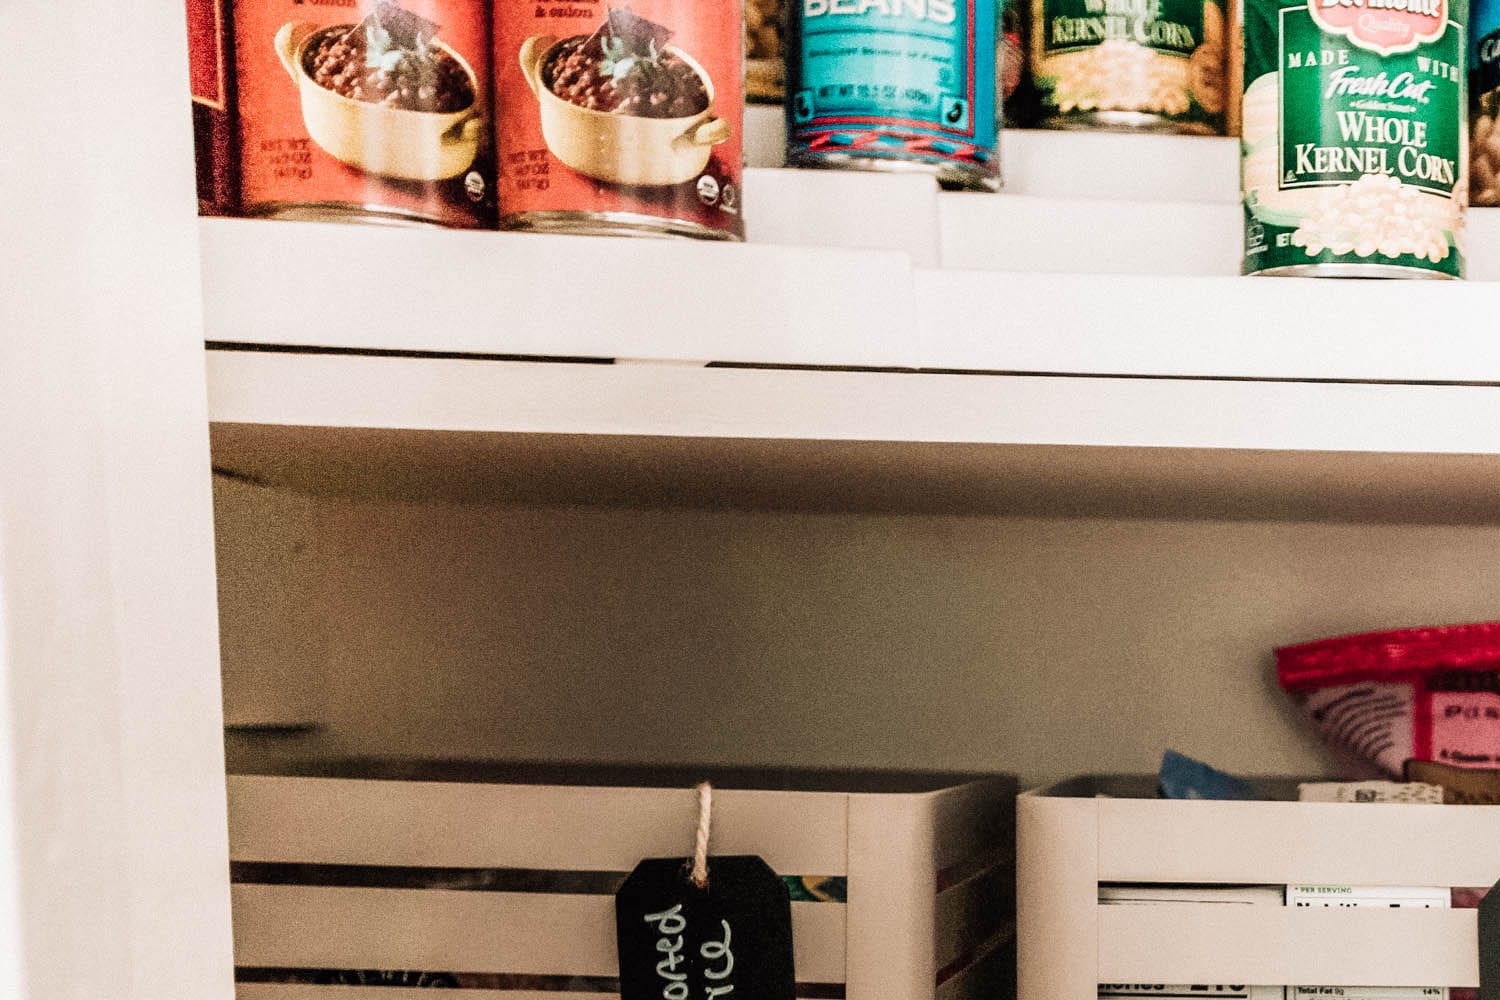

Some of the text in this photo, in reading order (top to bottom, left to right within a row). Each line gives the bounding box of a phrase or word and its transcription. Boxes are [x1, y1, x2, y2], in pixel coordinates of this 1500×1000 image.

[803, 0, 956, 24] BEANS
[1053, 15, 1195, 48] KERNEL CORN
[1288, 50, 1459, 82] MADE WITH
[1324, 66, 1389, 99] Fresh
[1337, 111, 1427, 148] WHOLE
[1295, 143, 1454, 184] KERNEL CORN
